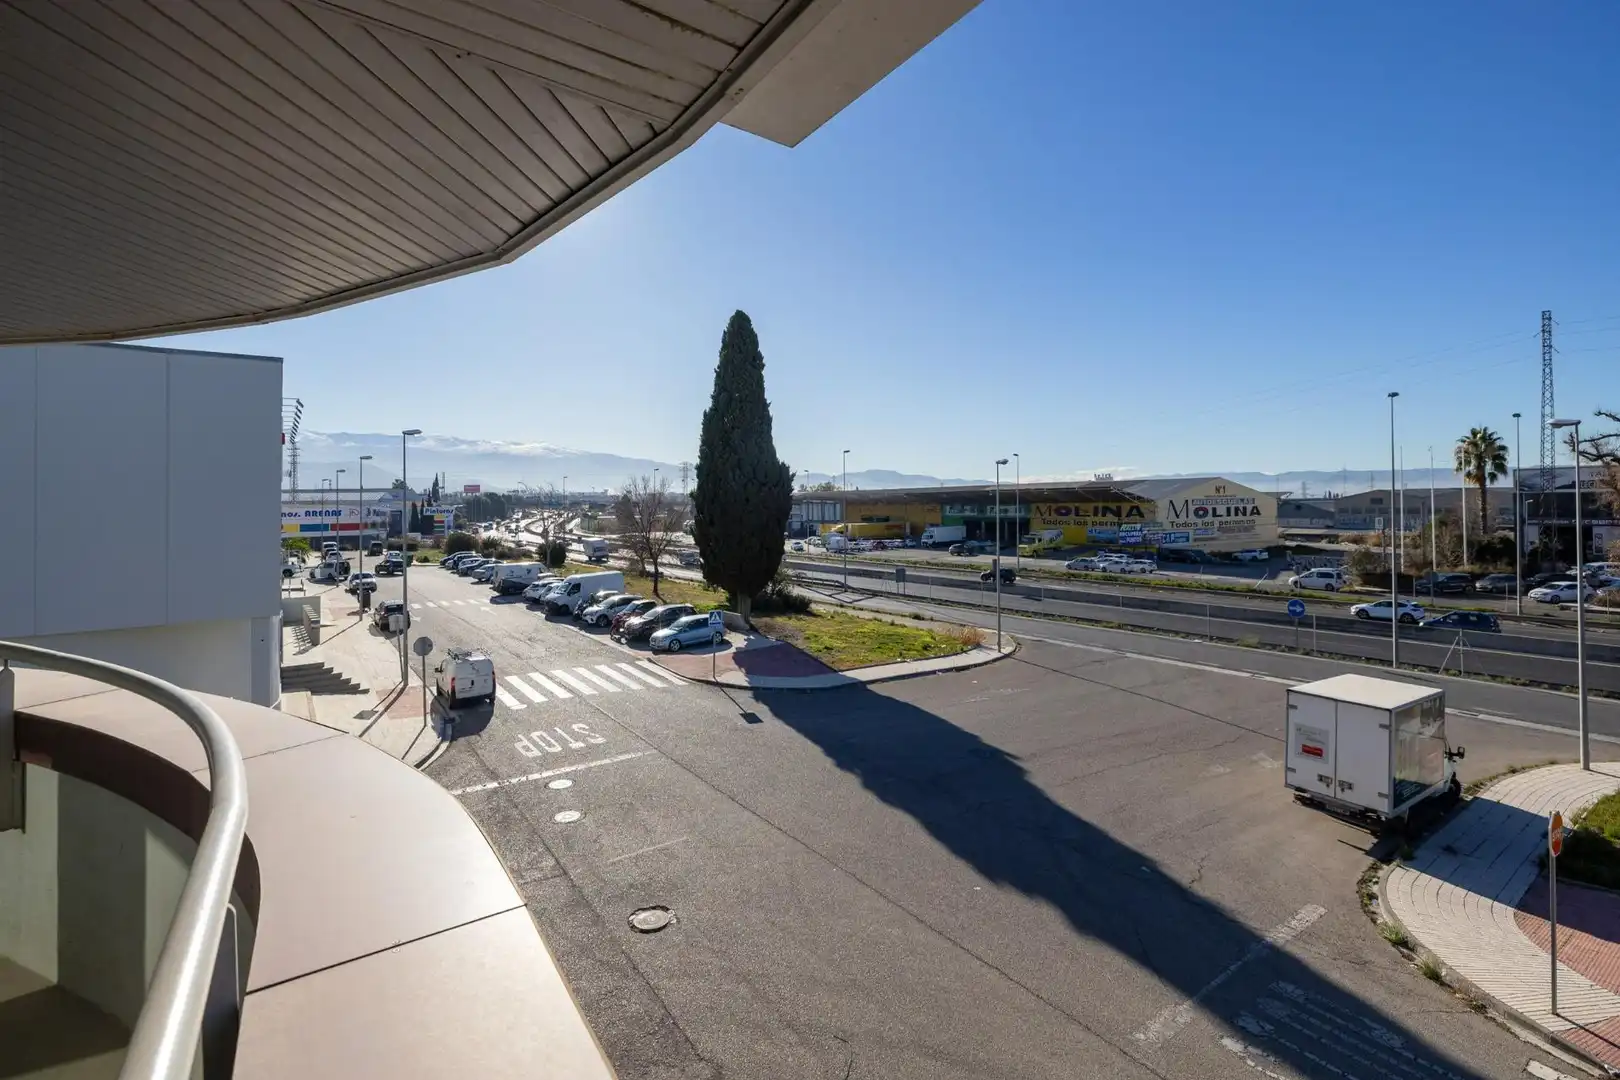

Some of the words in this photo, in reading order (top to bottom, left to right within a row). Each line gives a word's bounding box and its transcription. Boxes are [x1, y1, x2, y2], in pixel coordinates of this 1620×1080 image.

[304, 509, 343, 517] ARENAS
[1034, 505, 1145, 518] MOLINA
[1166, 499, 1262, 520] MOLINA
[1041, 518, 1070, 526] Todos
[1072, 518, 1089, 527] los
[1169, 520, 1198, 529] Todos
[1201, 519, 1215, 527] los
[1218, 519, 1256, 527] permisos
[514, 723, 607, 758] STOP
